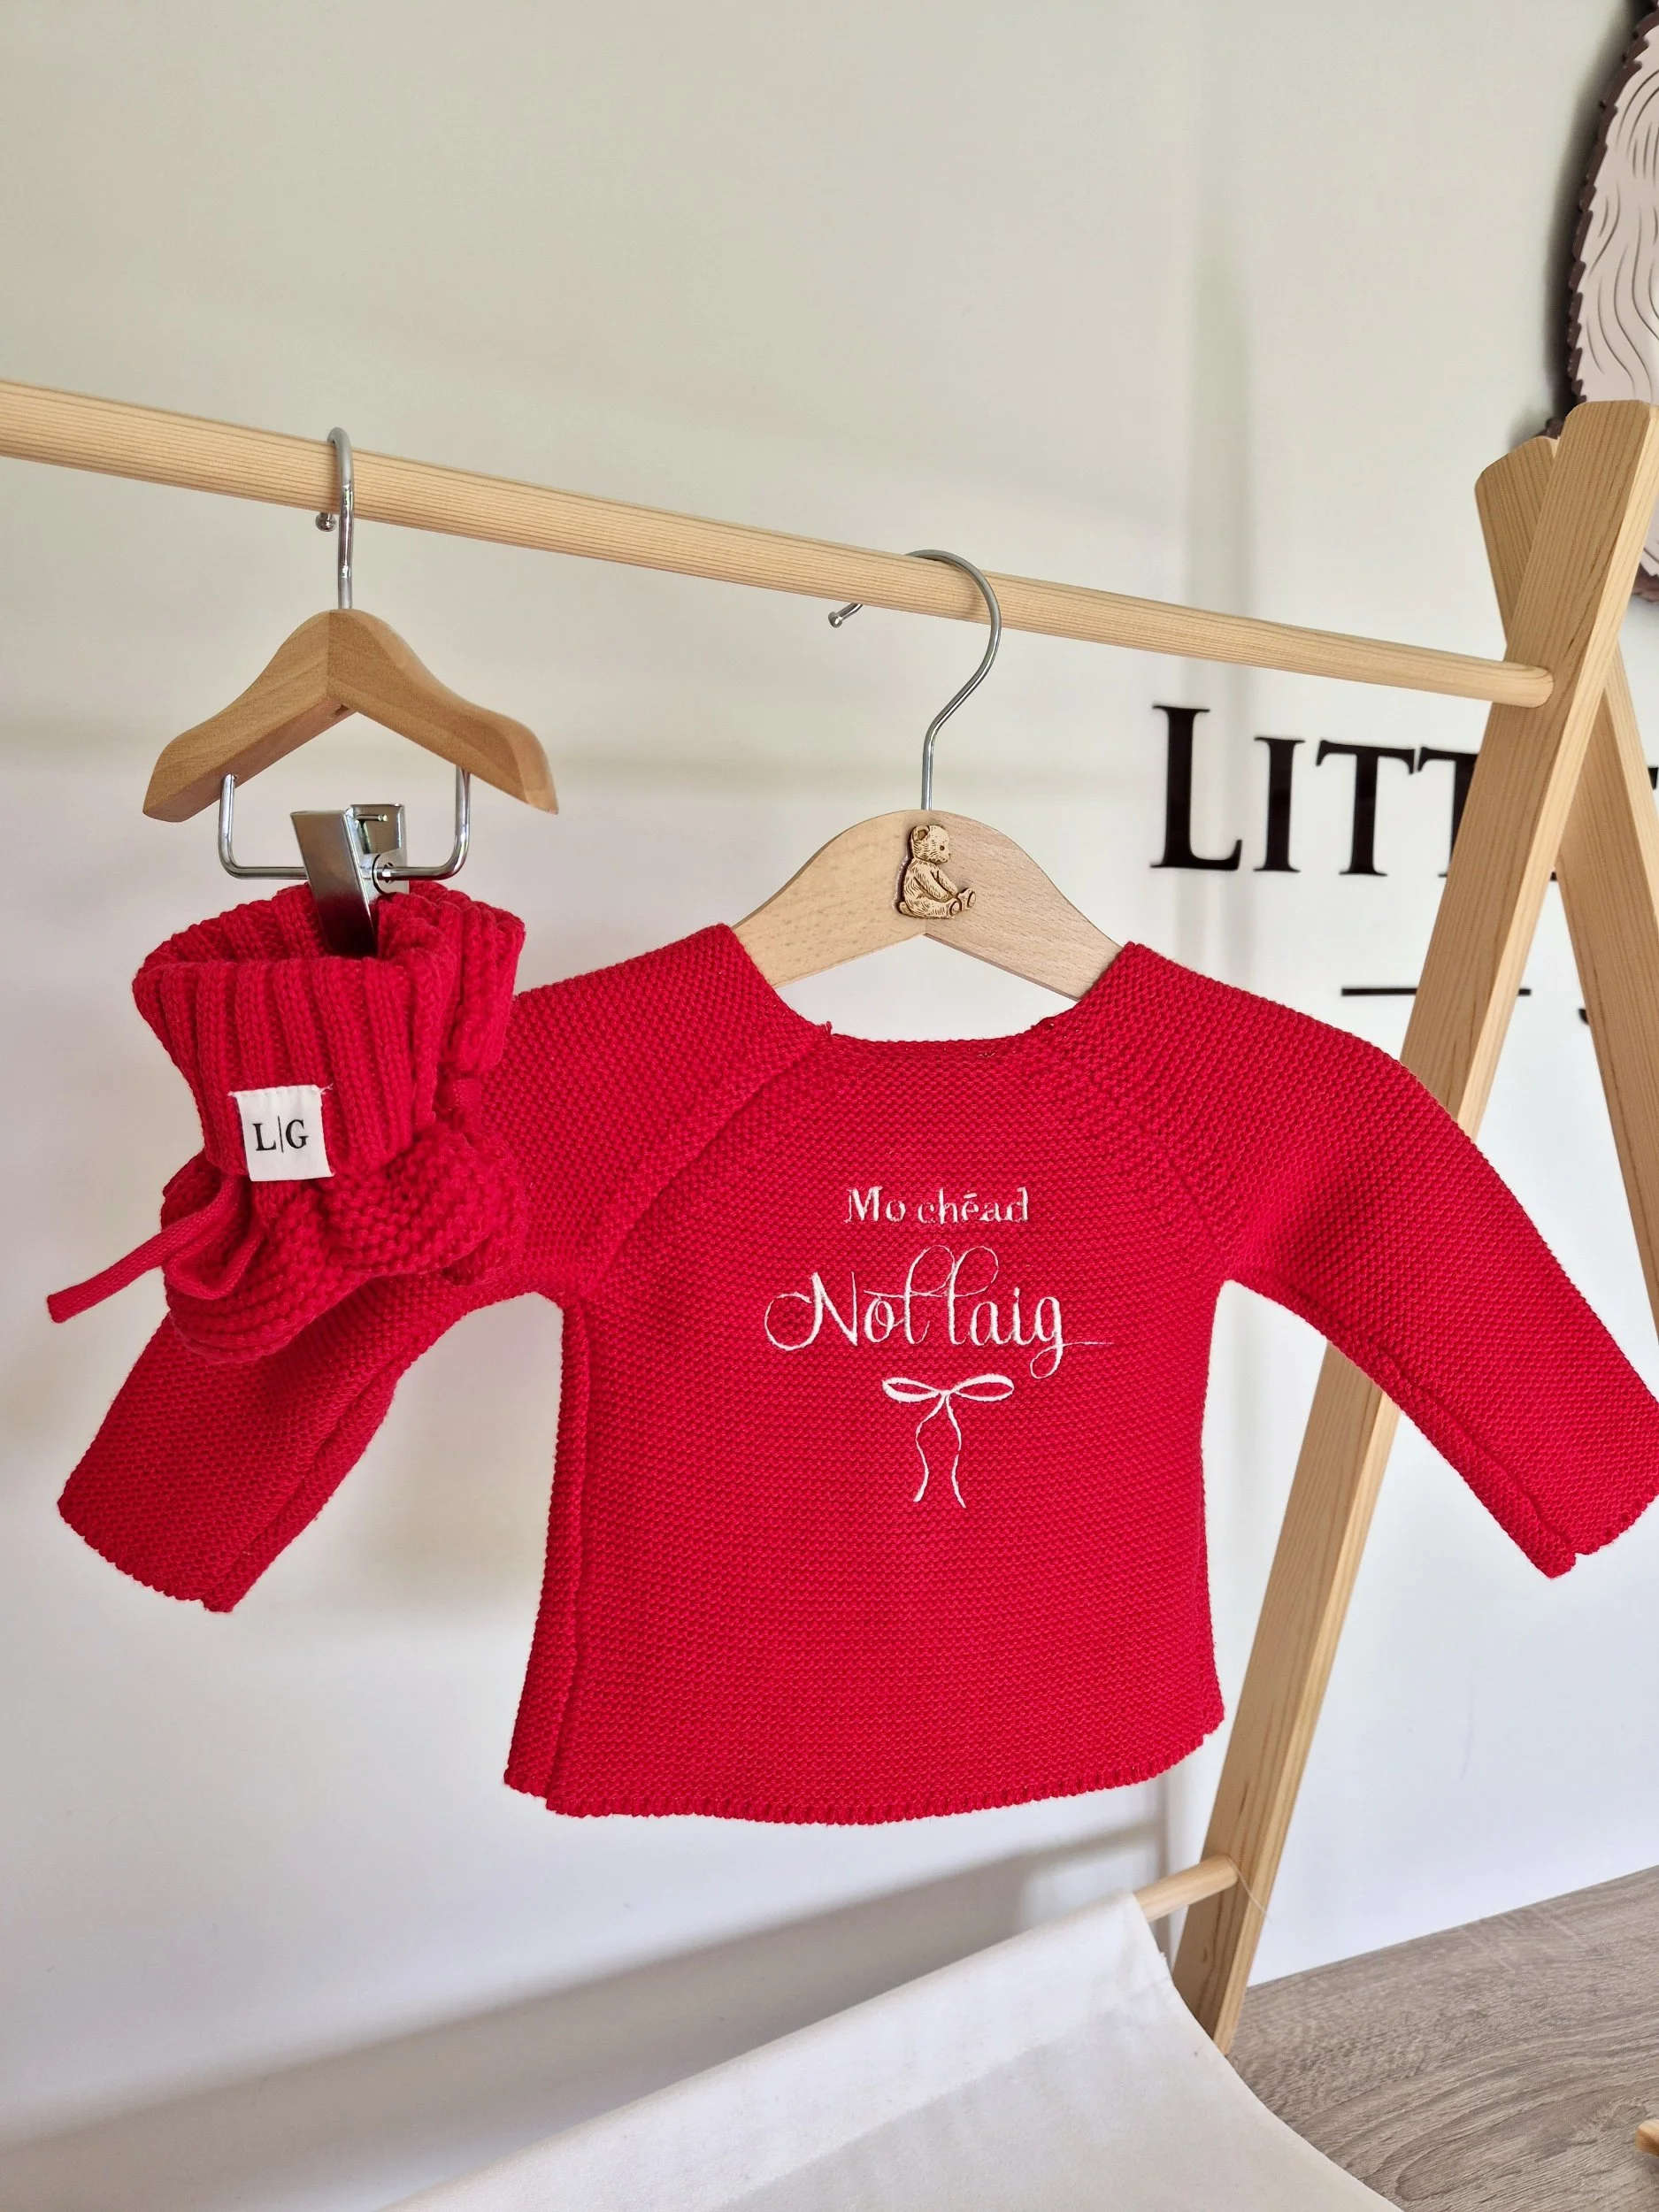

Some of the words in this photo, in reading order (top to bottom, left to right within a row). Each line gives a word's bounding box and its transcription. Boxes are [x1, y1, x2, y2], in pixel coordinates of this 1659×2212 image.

[1150, 705, 1658, 882] LITT
[844, 1186, 906, 1224] Mo
[764, 1244, 1115, 1379] Nollaig
